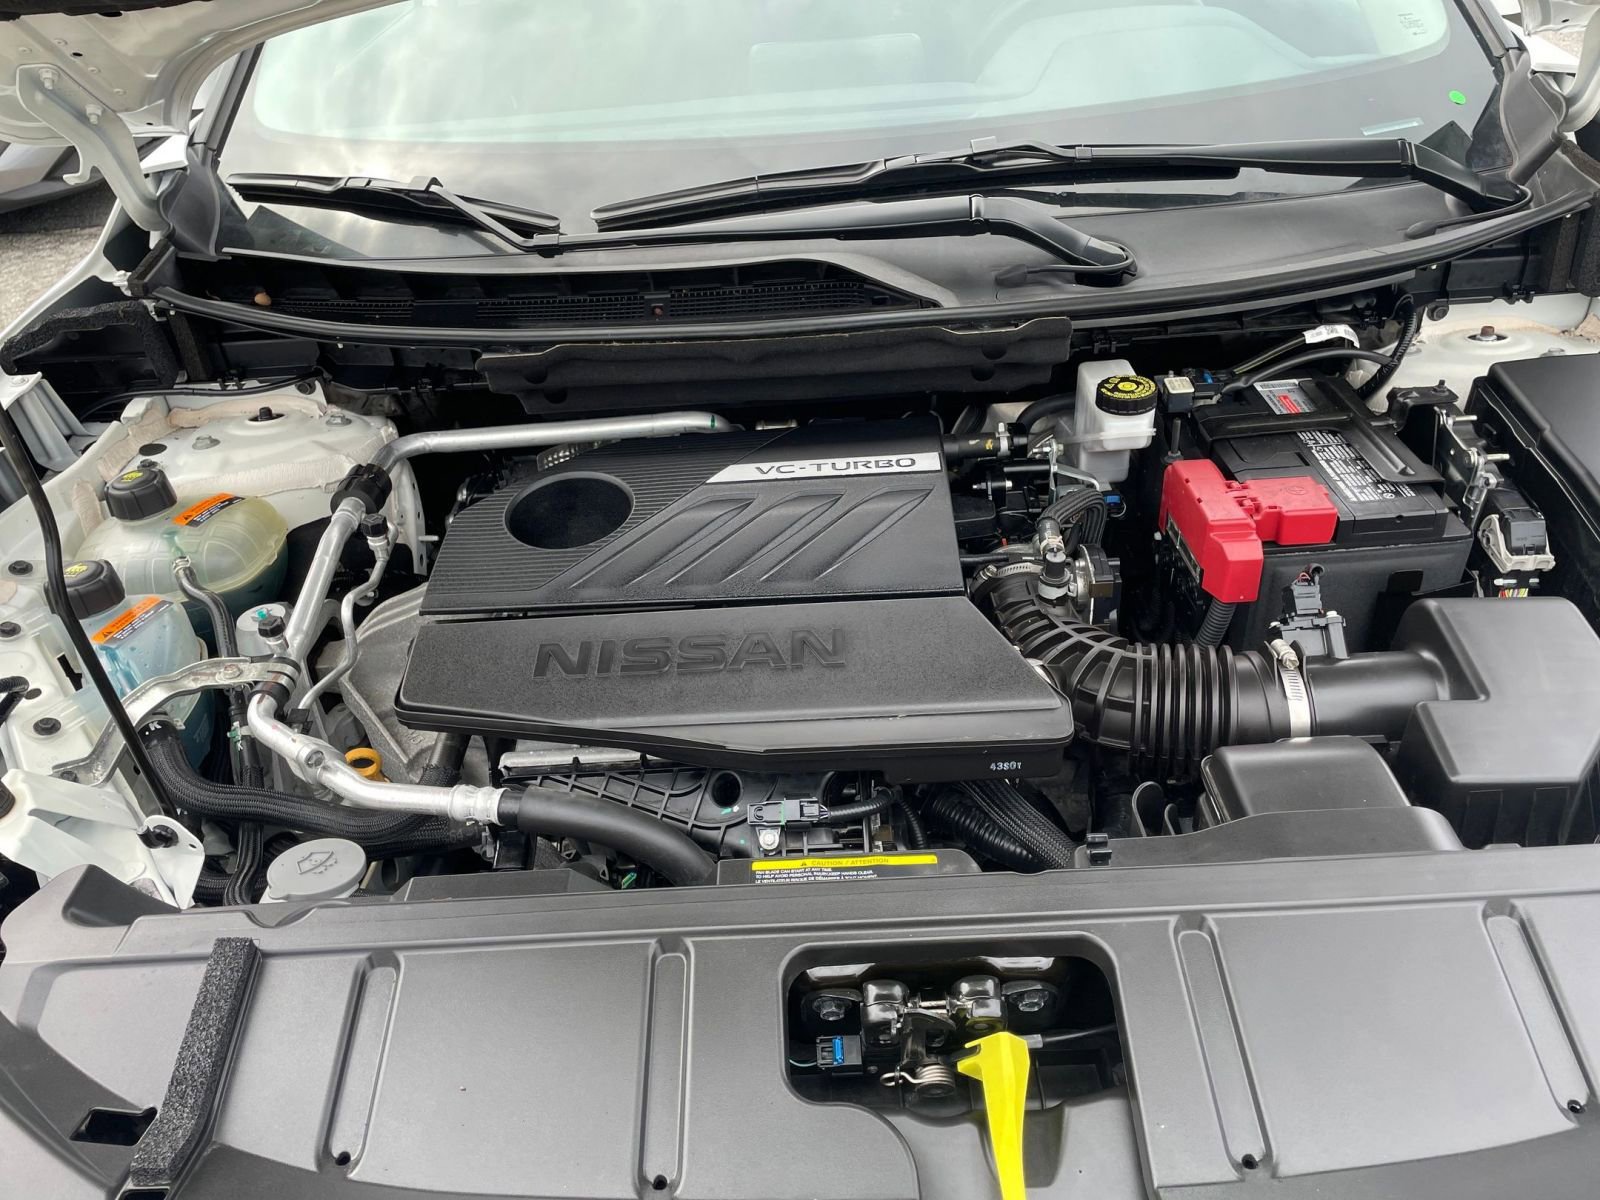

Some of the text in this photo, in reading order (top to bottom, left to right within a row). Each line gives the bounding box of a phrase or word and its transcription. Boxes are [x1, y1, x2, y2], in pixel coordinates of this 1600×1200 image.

[755, 458, 916, 475] VC-TURBO
[532, 628, 846, 680] NISSAN
[811, 859, 845, 867] CAUTION
[849, 857, 889, 866] ATTENTION
